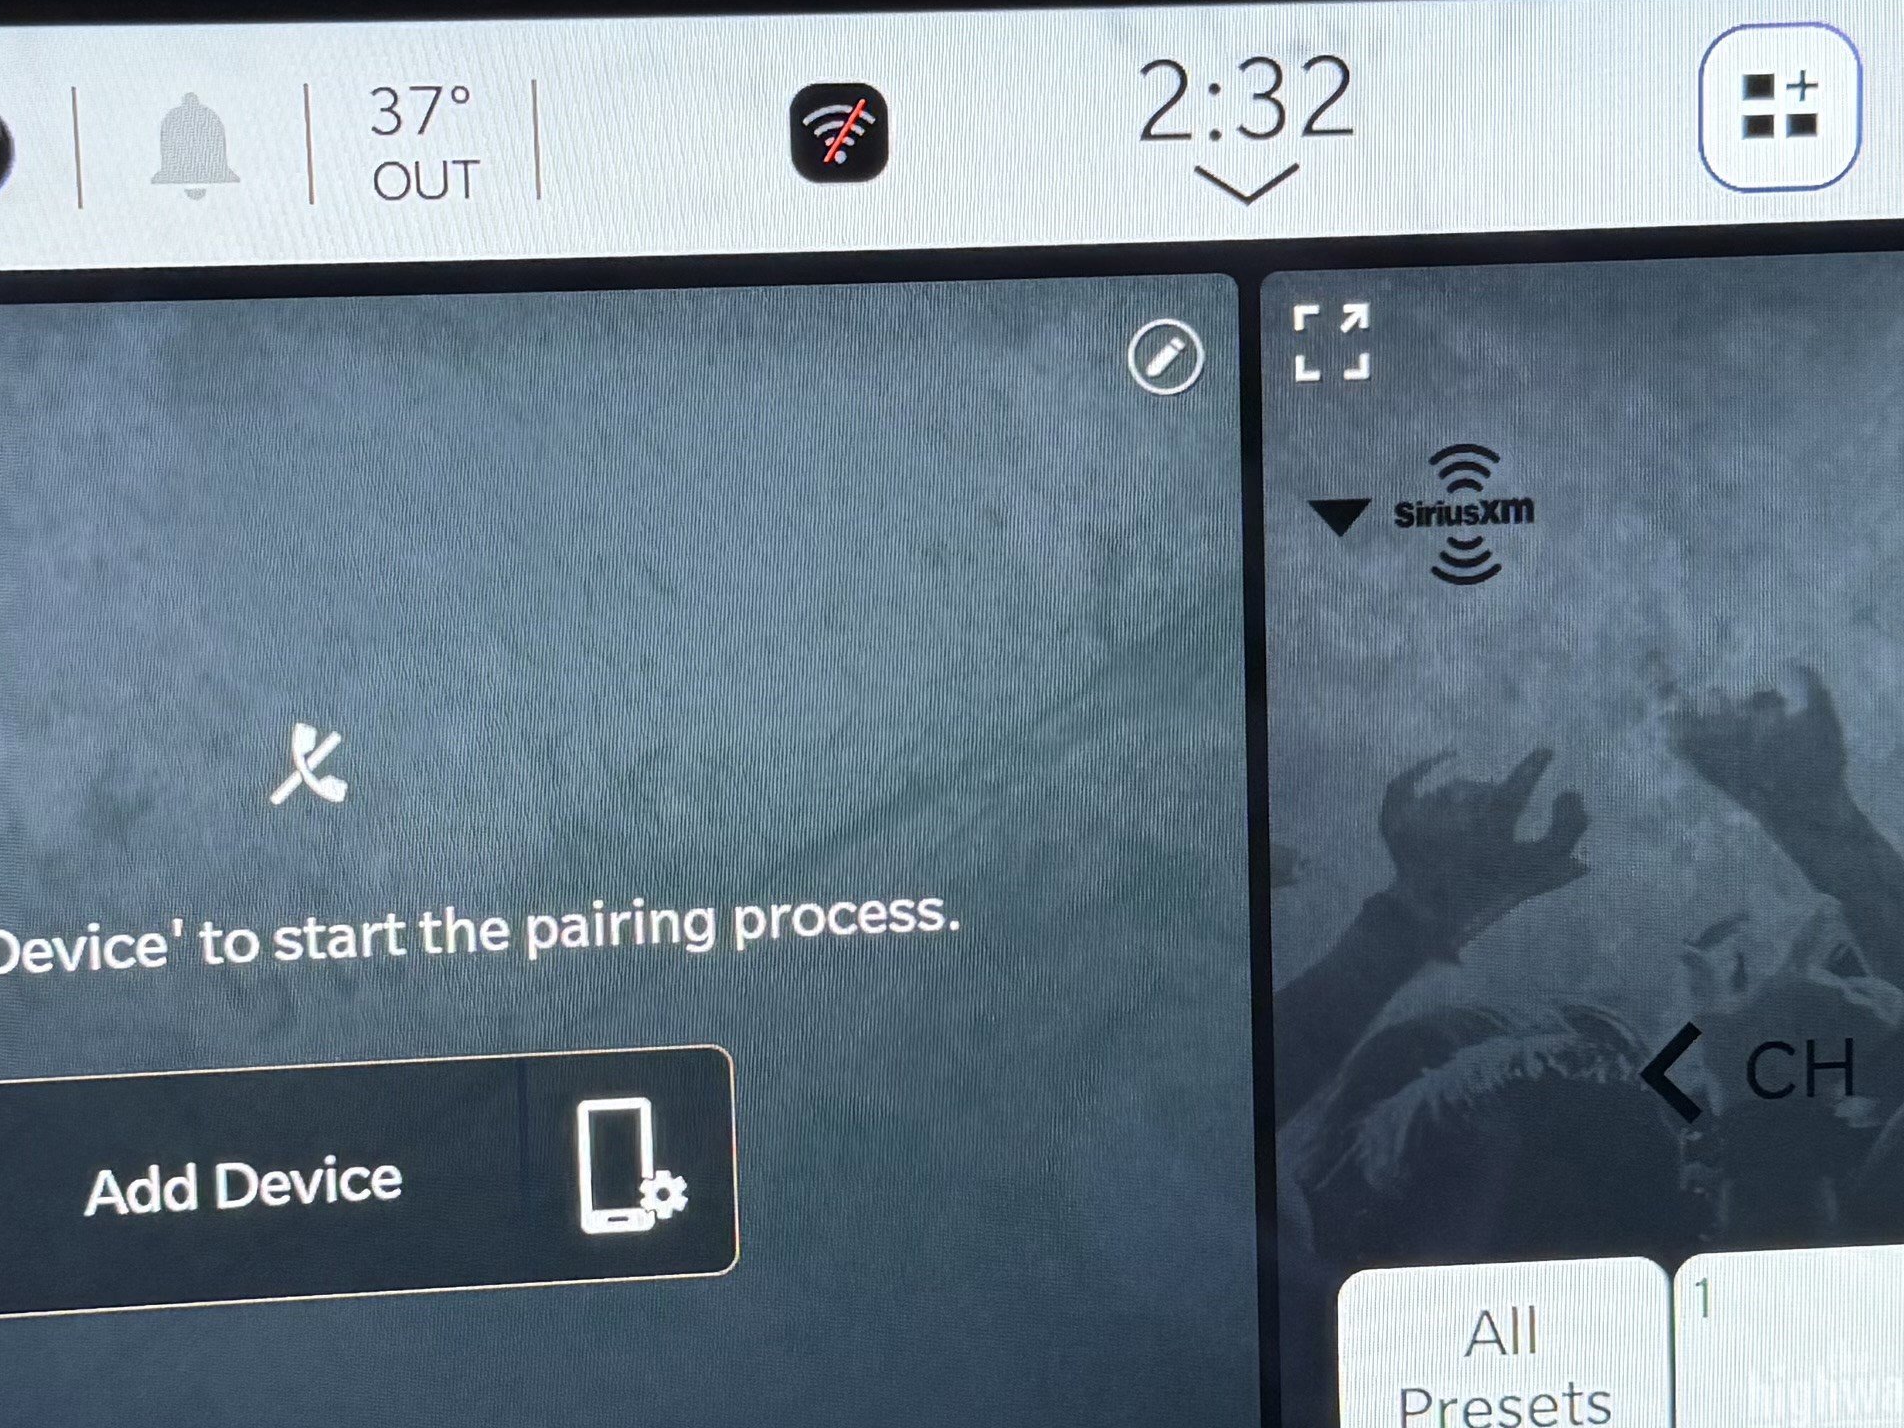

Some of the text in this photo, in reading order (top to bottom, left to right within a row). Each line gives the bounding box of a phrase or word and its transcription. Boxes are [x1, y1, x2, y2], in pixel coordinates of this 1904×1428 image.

[1137, 53, 1356, 142] 2:32
[372, 159, 481, 202] OUT
[197, 918, 259, 967] to
[274, 911, 407, 960] start
[418, 905, 510, 954] the
[526, 898, 718, 960] pairing
[734, 897, 962, 954] process.
[1745, 1037, 1856, 1101] CH
[84, 1154, 403, 1217] Add Device
[1695, 1278, 1709, 1318] 1
[1464, 1305, 1536, 1357] All
